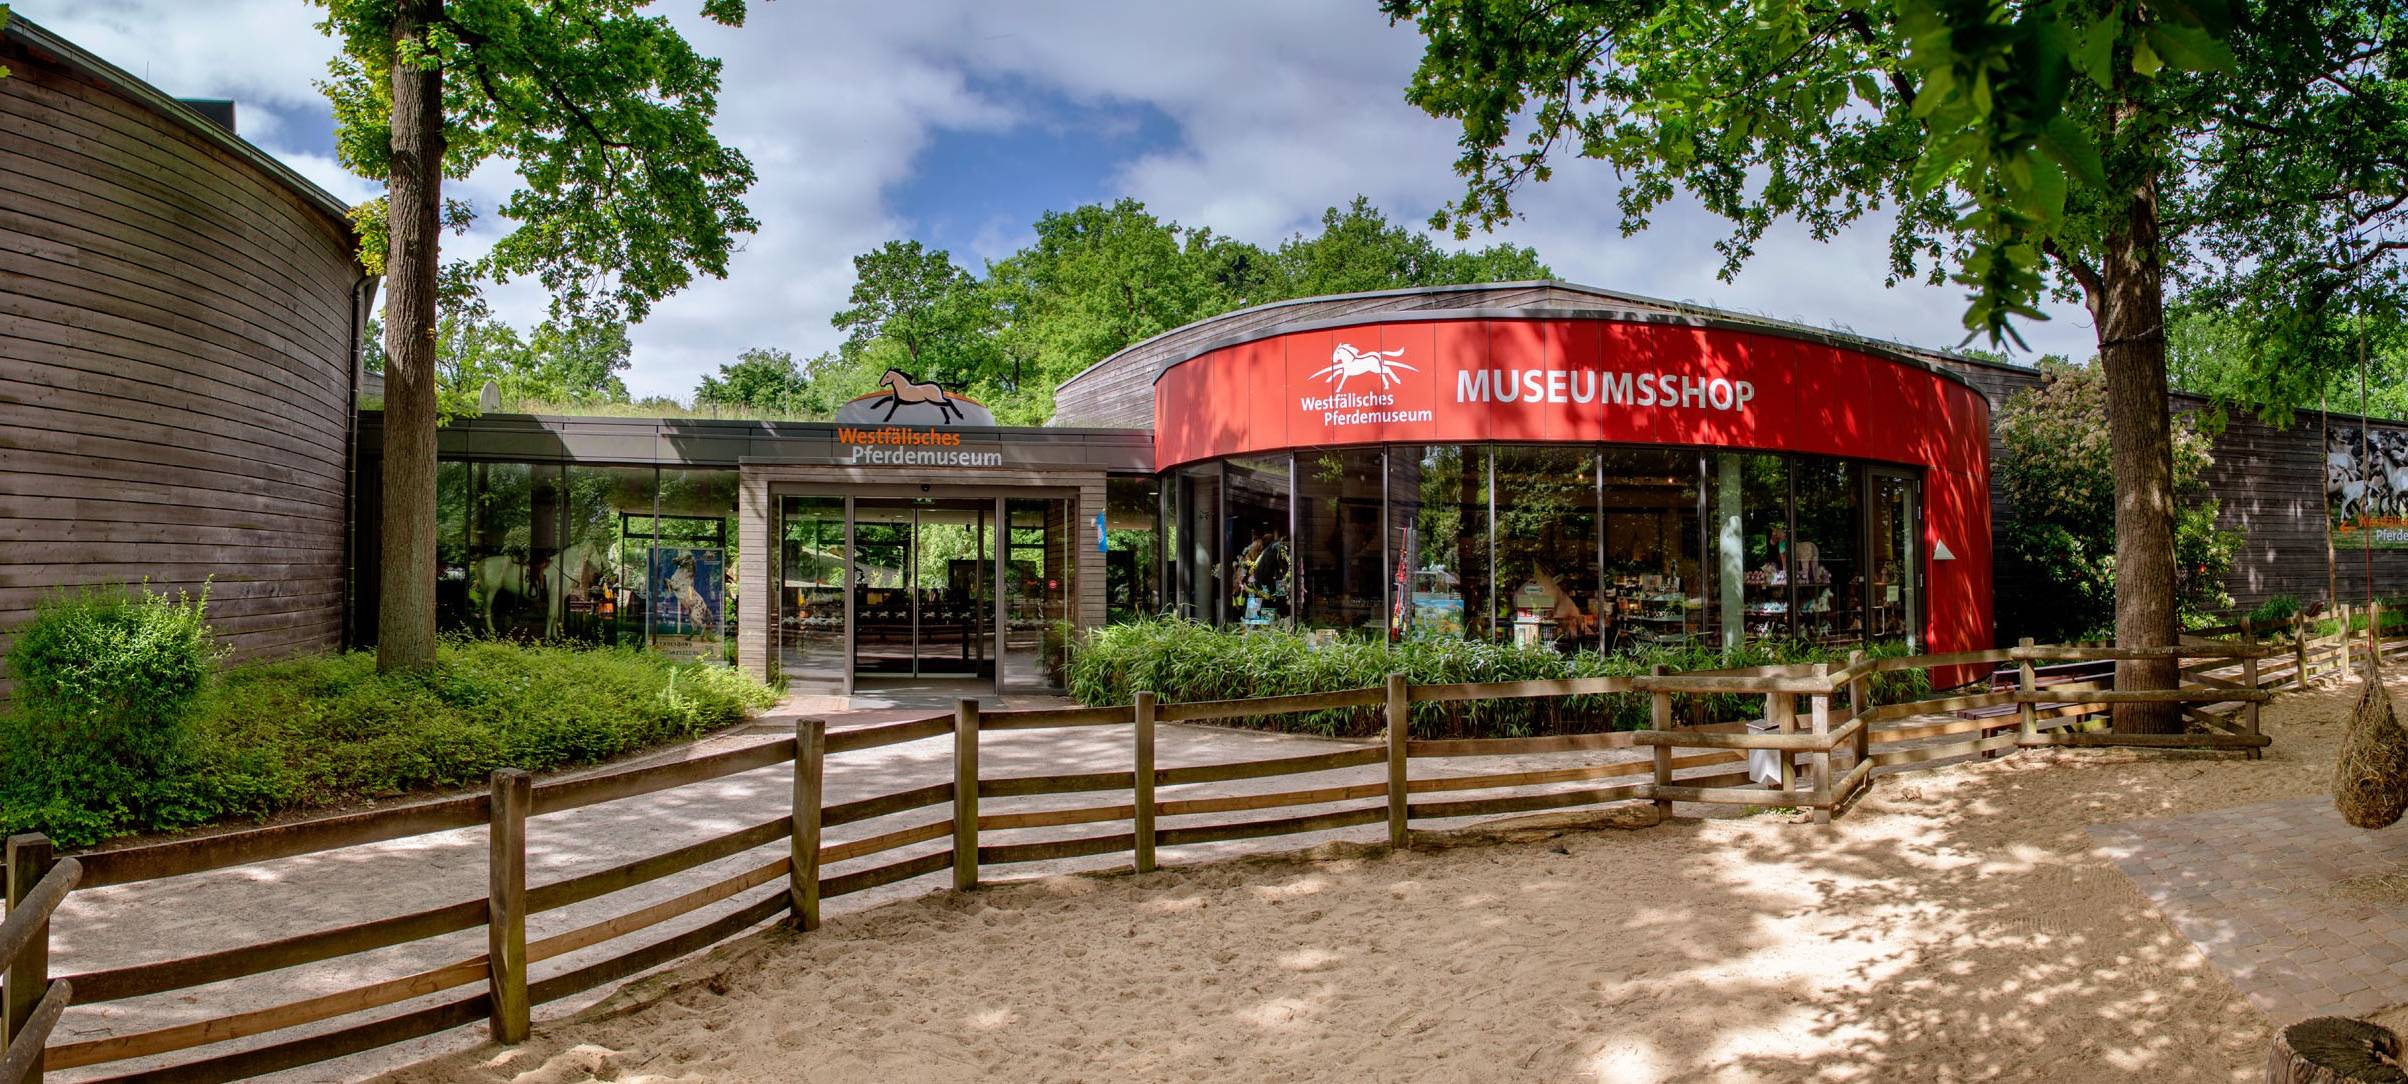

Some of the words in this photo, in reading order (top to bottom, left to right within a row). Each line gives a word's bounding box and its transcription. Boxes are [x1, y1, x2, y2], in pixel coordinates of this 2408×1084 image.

[1456, 369, 1755, 412] MUSEUMSSHOP
[1301, 391, 1394, 411] Westfälisches
[1324, 409, 1433, 426] Pferdemuseum
[837, 426, 961, 446] Westfälisches
[852, 446, 1002, 466] Pferdemuseum
